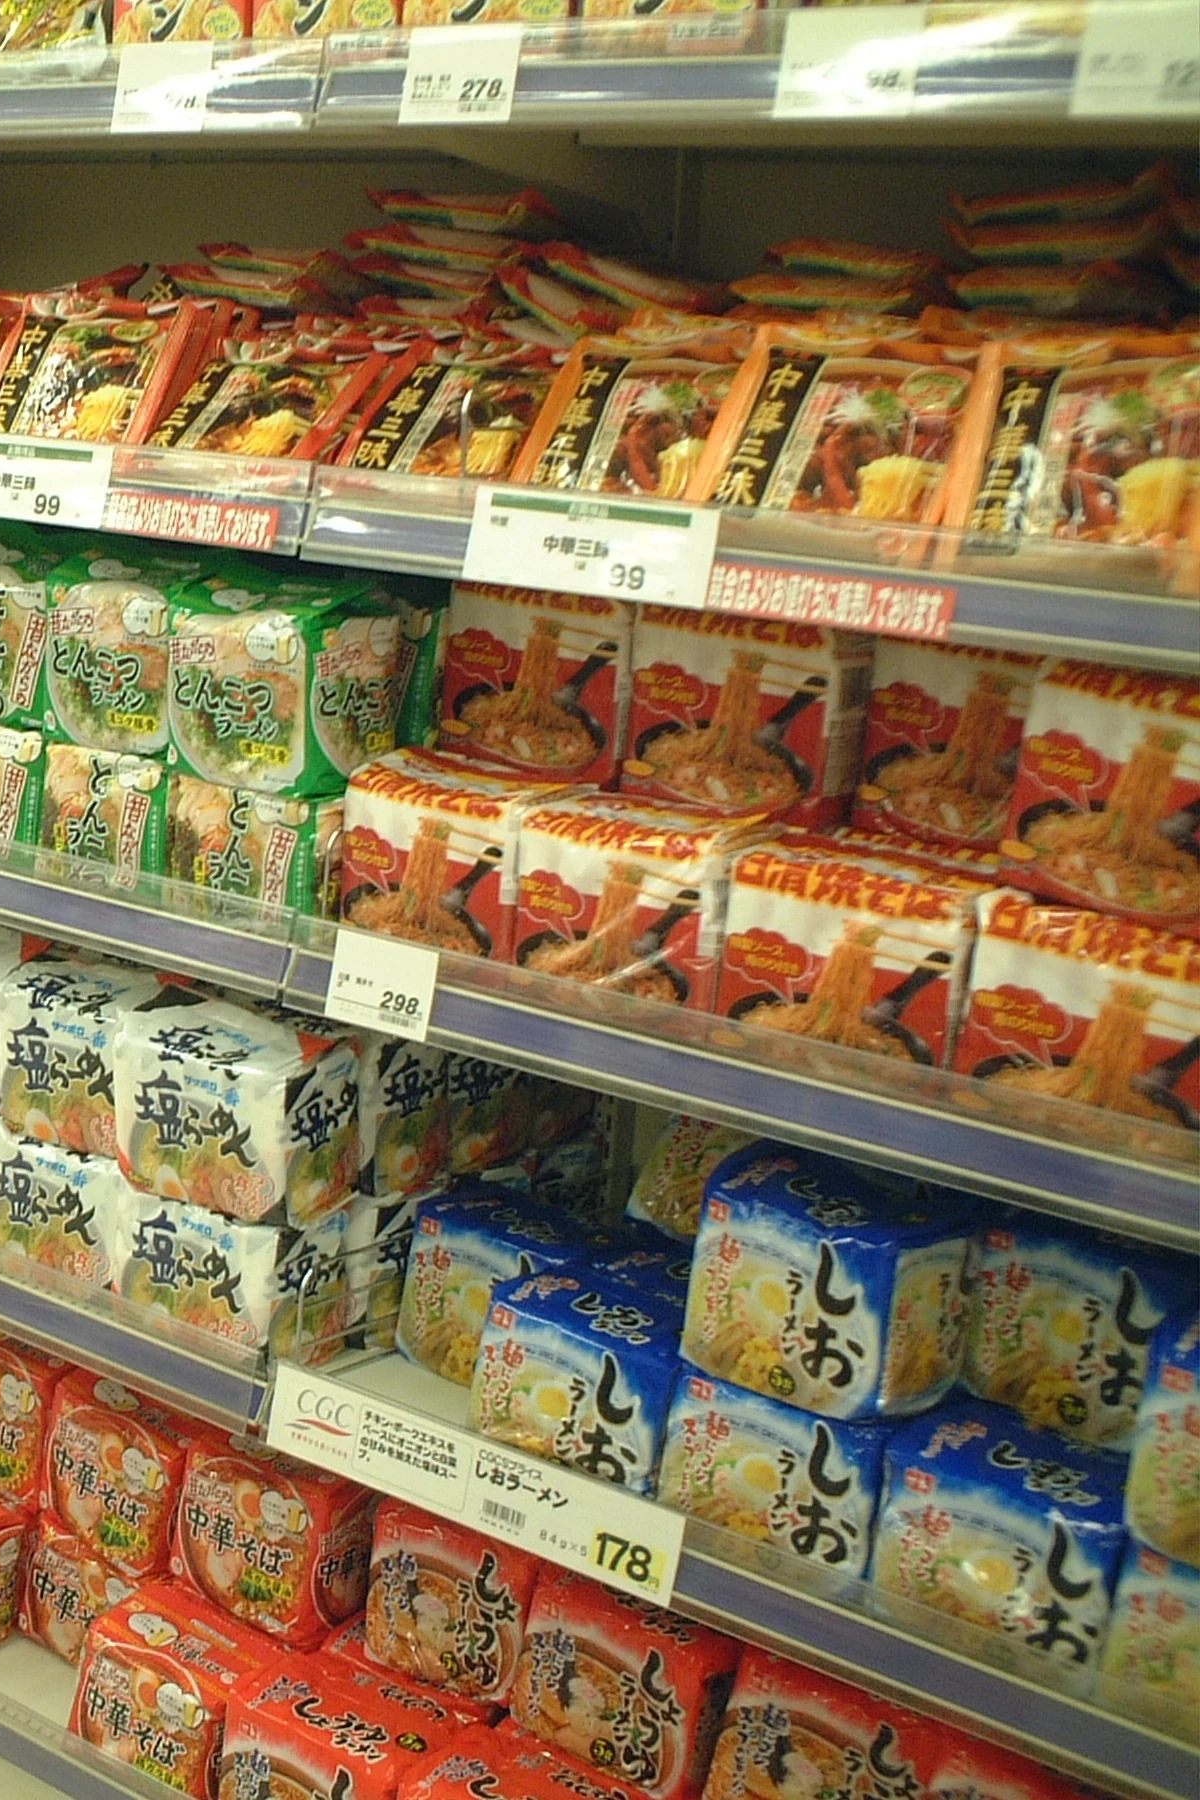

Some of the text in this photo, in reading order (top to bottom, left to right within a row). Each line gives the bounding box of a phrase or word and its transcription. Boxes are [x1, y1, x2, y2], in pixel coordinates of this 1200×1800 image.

[460, 78, 502, 100] 278
[356, 363, 442, 469] 中華三昧
[716, 362, 804, 507] 中華三昧
[33, 494, 61, 516] 99
[608, 563, 646, 591] 99
[51, 638, 141, 685] とんこつ
[91, 683, 146, 711] ラーメン
[173, 669, 273, 717] とんこつ
[214, 713, 282, 742] ラーメン
[50, 1019, 108, 1049] サッポロ一番
[380, 991, 420, 1015] 298
[6, 1016, 115, 1107] 塩らーめん
[184, 1074, 241, 1108] サッポロ一番
[133, 1069, 257, 1168] 塩らーめん
[34, 1154, 89, 1190] サッポロ一番
[131, 1209, 244, 1315] 塩らーめん
[179, 1215, 234, 1252] サッポロ一番
[782, 1268, 804, 1356] ラーメン
[800, 1240, 867, 1389] しお
[296, 1388, 356, 1429] CGC
[555, 1377, 587, 1457] ラーメン
[575, 1350, 638, 1486] しお
[54, 1447, 148, 1527] 中華そば
[475, 1460, 569, 1508] しおラーメン
[770, 1448, 796, 1532] ラーメン
[789, 1422, 859, 1565] しお
[186, 1503, 295, 1576] 中華そば
[596, 1531, 653, 1583] 178
[464, 1549, 522, 1691] しょうゆ
[1025, 1520, 1099, 1666] しお
[86, 1686, 188, 1768] 中華そば
[293, 1697, 389, 1744] しょうゆ
[617, 1647, 684, 1785] しょうゆ
